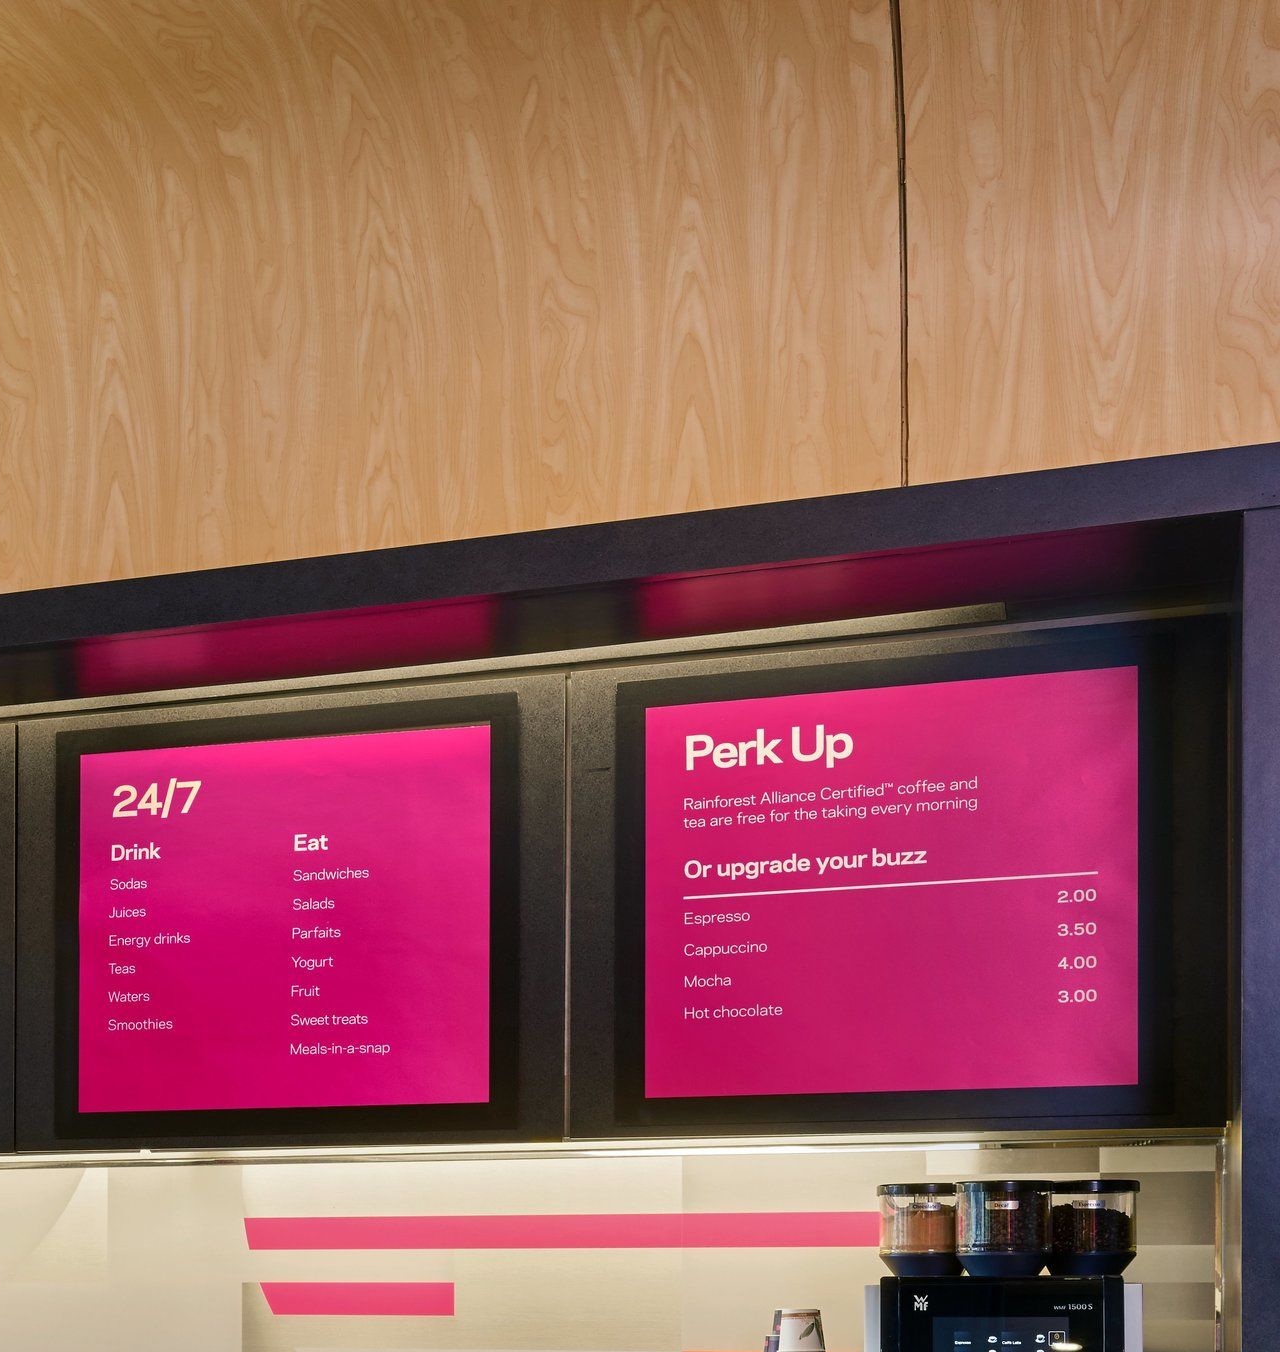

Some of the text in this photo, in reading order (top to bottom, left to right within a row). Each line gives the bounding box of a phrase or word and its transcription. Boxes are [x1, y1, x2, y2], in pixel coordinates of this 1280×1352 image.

[686, 725, 853, 770] Perk Up
[113, 778, 201, 818] 24/7
[684, 795, 756, 810] Rainforest
[760, 791, 816, 804] Alliance
[898, 780, 945, 794] coffee
[950, 776, 977, 790] and
[684, 797, 977, 828] tea are free for the taking every morning
[294, 834, 328, 851] Eat
[112, 842, 161, 861] Drink
[684, 848, 927, 880] Or upgrade your buzz
[293, 867, 369, 881] Sandwiches
[110, 878, 147, 890] Sodas
[1058, 889, 1096, 903] 2.00
[293, 898, 334, 910] Salads
[109, 907, 146, 918] Juices
[684, 912, 750, 926] Espresso
[292, 927, 341, 939] Parfaits
[1058, 922, 1096, 936] 3.50
[109, 932, 190, 948] Energy drinks
[684, 942, 767, 958] Cappuccino
[109, 963, 135, 974] Teas
[292, 957, 333, 970] Yogurt
[1058, 956, 1097, 969] 4.00
[685, 974, 731, 987] Mocha
[108, 991, 149, 1002] Waters
[291, 985, 320, 997] Fruit
[1058, 989, 1097, 1003] 3.00
[685, 1004, 782, 1019] Hot chocolate
[108, 1019, 173, 1030] Smoothies
[291, 1014, 368, 1026] Sweet treats
[291, 1043, 390, 1055] Meals-in-a-snap
[1068, 1303, 1087, 1311] 1500
[1088, 1303, 1093, 1311] S
